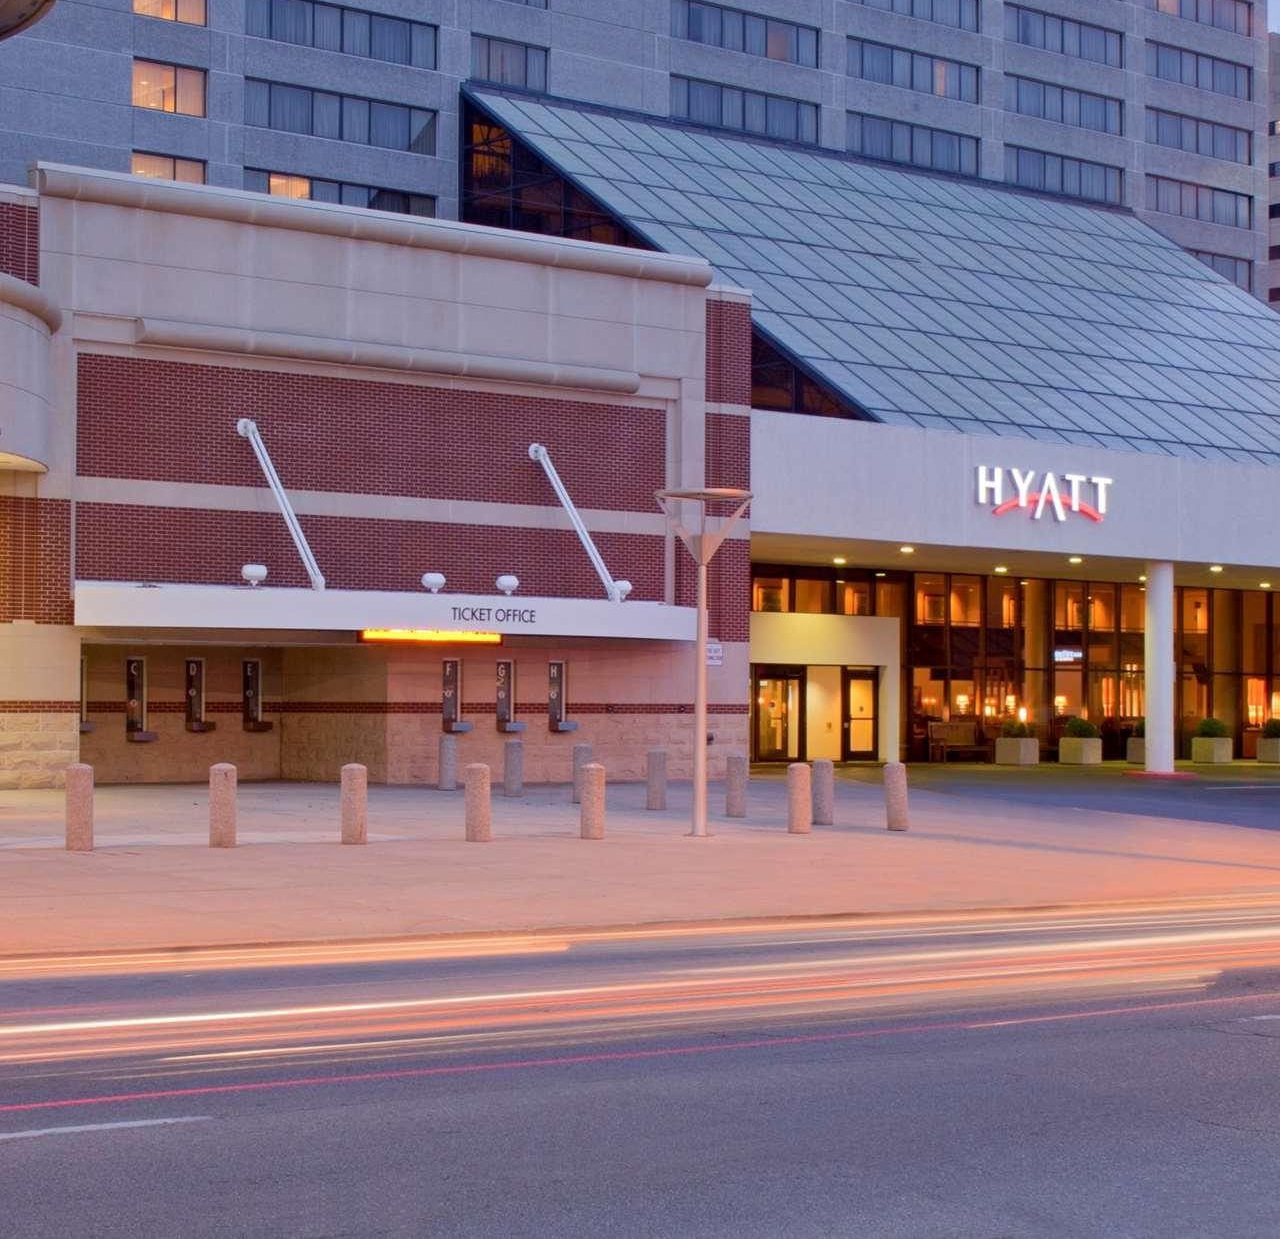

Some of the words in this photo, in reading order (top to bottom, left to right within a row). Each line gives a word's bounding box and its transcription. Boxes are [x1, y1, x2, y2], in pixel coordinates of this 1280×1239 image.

[976, 465, 1113, 522] HYATT
[451, 607, 492, 622] TICKET
[495, 608, 536, 623] OFFICE
[130, 663, 138, 675] C
[189, 663, 197, 675] D
[247, 664, 253, 676] E
[445, 663, 452, 676] F
[498, 664, 506, 677] G
[550, 665, 558, 678] H
